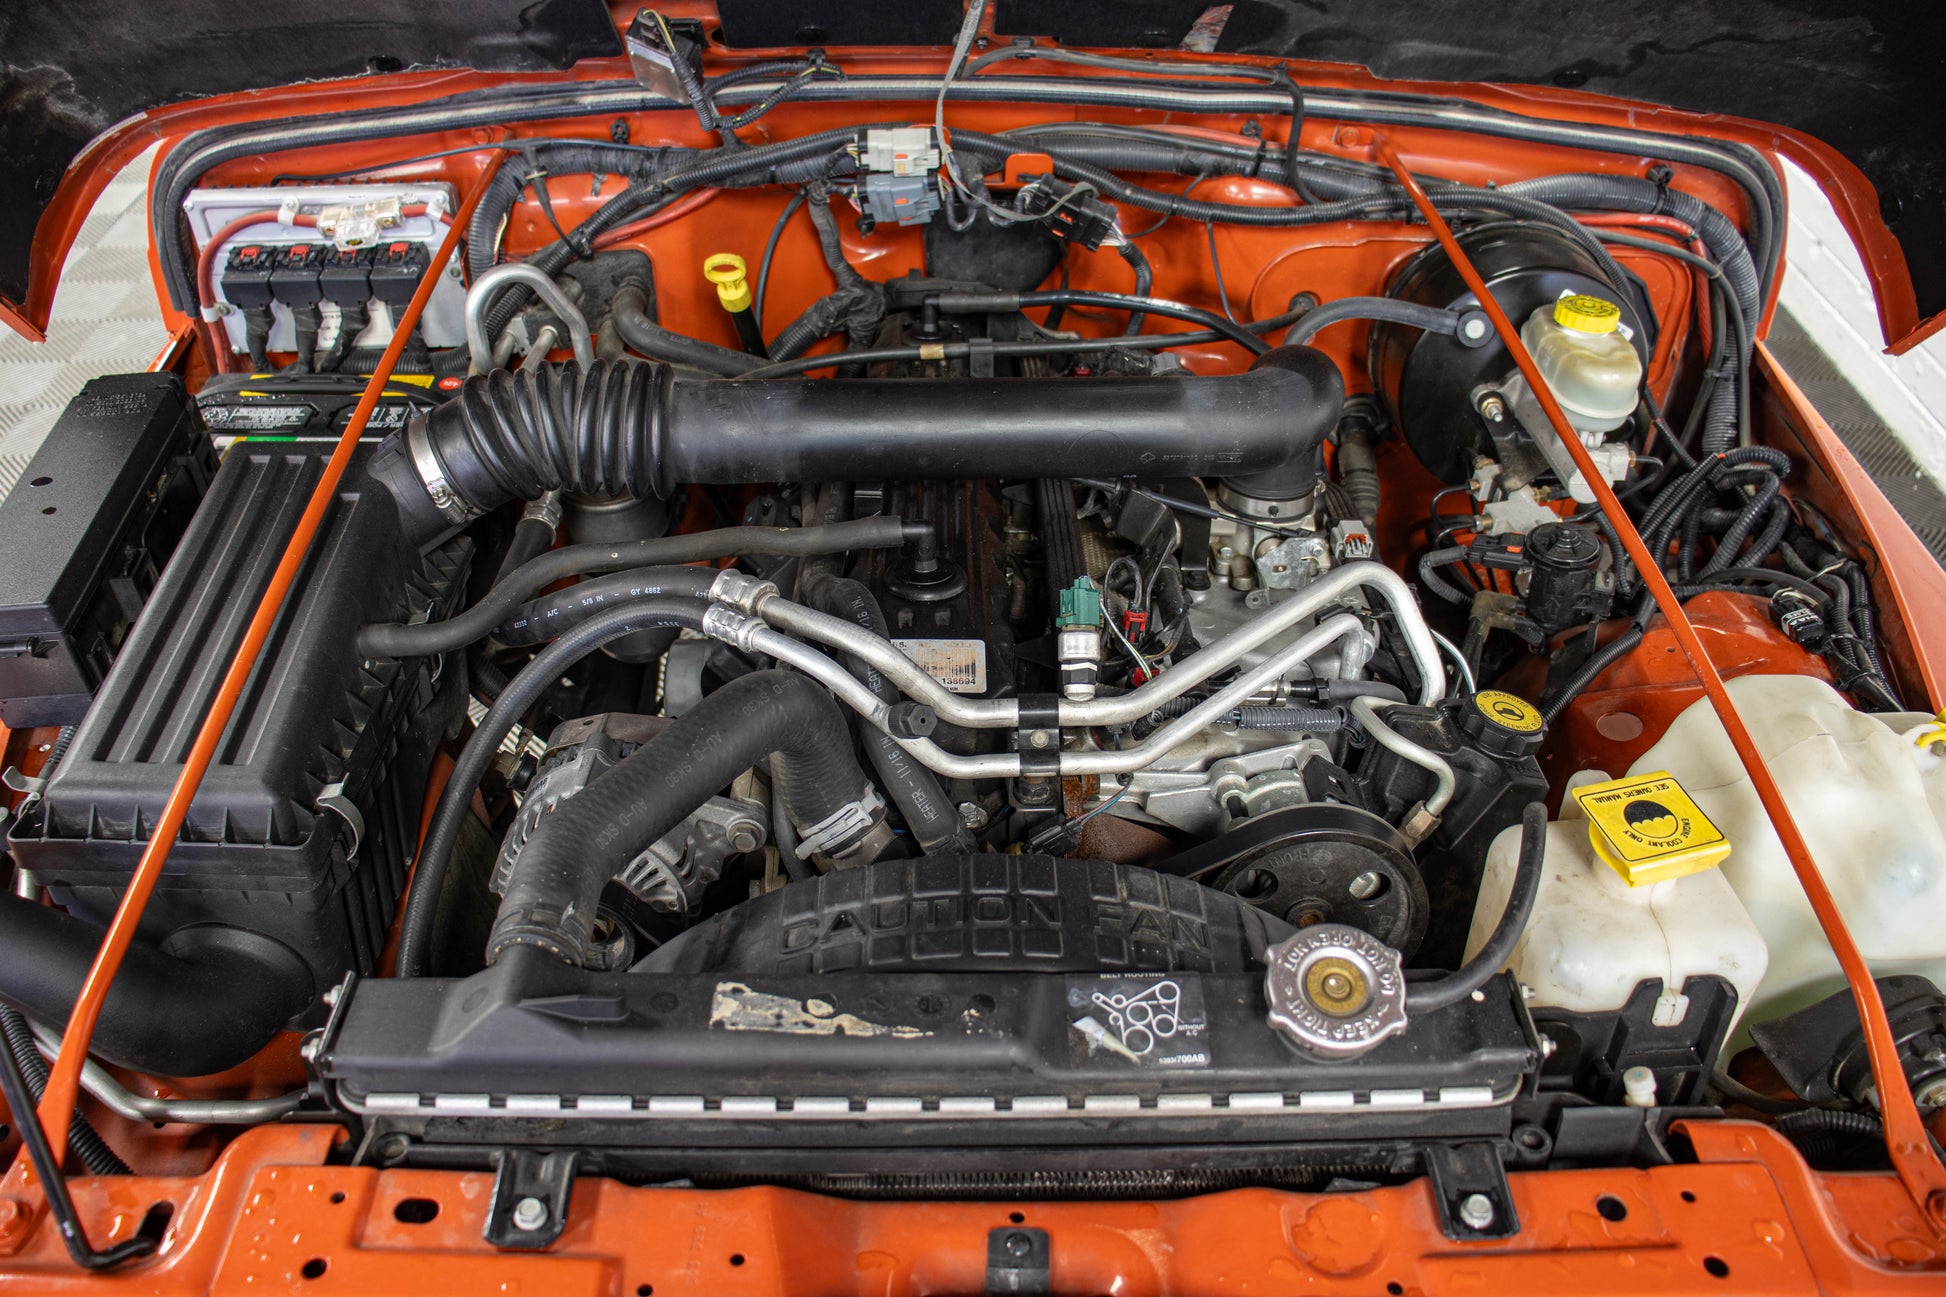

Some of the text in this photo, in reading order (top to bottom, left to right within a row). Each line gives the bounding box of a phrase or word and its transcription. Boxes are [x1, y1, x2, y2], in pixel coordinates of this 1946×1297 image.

[547, 608, 559, 618] A/C
[582, 597, 594, 606] 5/8
[742, 692, 770, 717] SK30
[665, 730, 723, 789] AU-D SK30
[888, 751, 912, 779] 11/16
[910, 787, 940, 823] HEATER
[1592, 783, 1670, 804] SEE OWNERS MANUAL
[595, 798, 648, 850] AU-D SK30
[1623, 817, 1690, 848] ENGINE COOLANT ONLY
[780, 895, 1211, 955] CAUTION FAN
[1307, 932, 1353, 949] OPEN
[1284, 943, 1310, 972] HOT
[1357, 942, 1390, 972] NOT
[1286, 999, 1380, 1039] KEEP TIGHT
